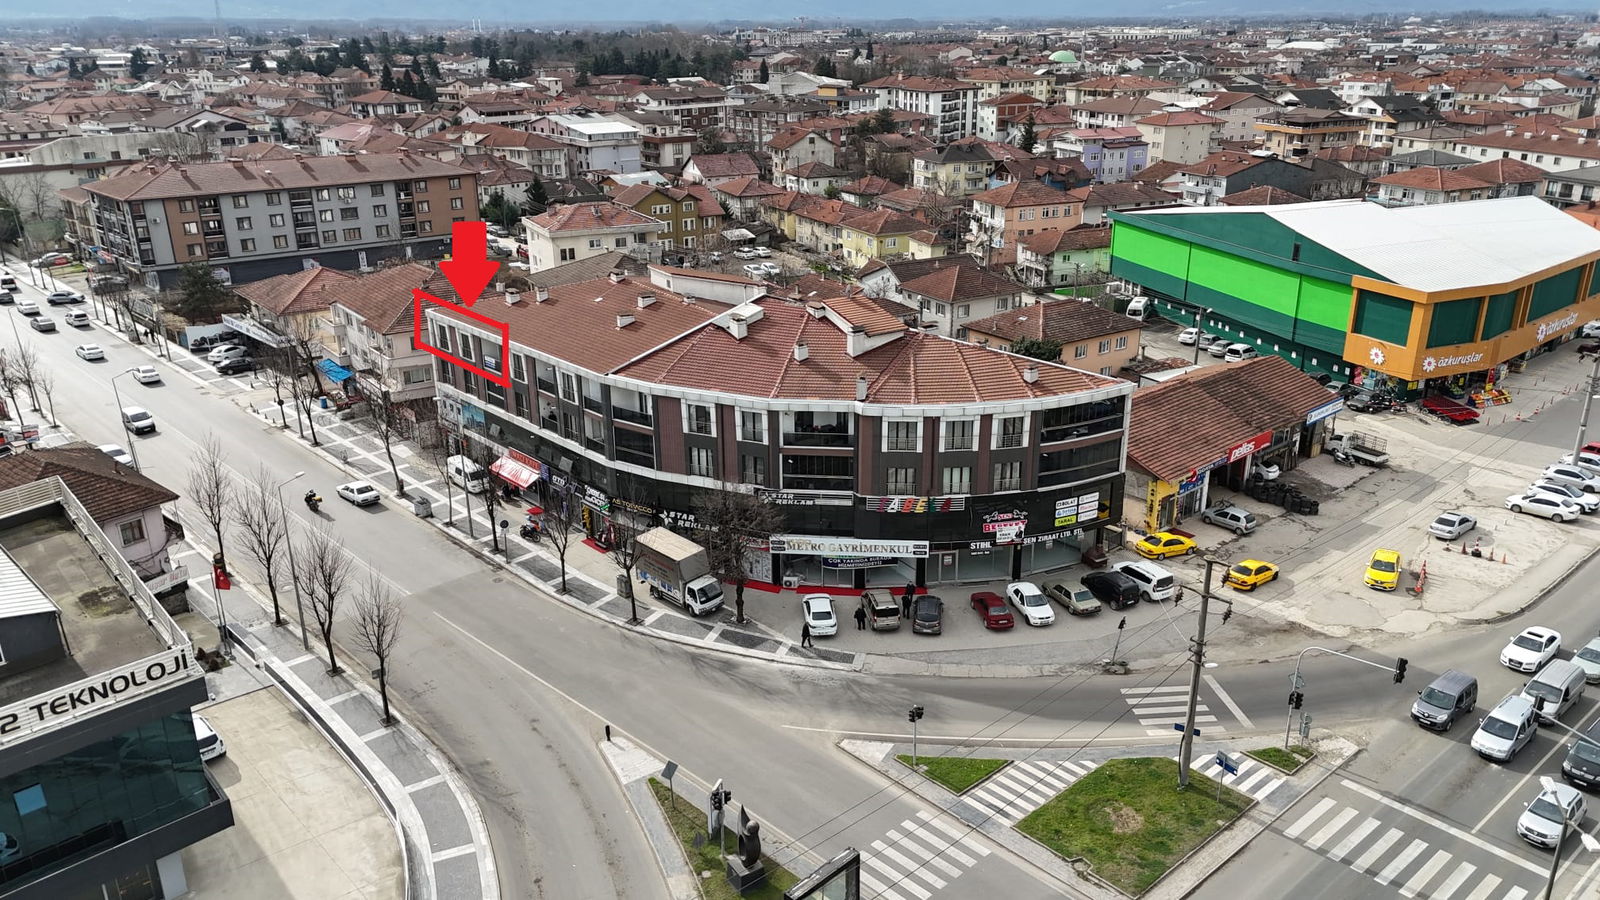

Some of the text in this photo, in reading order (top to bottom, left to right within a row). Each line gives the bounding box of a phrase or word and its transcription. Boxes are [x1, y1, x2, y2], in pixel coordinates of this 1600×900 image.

[1437, 351, 1484, 368] özkuruşlar
[876, 496, 952, 512] TABELA
[669, 511, 695, 521] STAR
[786, 541, 825, 552] METRO
[828, 541, 912, 554] GAYRİMENKUL
[970, 541, 992, 550] STIHL
[29, 649, 189, 721] TEKNOLOJİ
